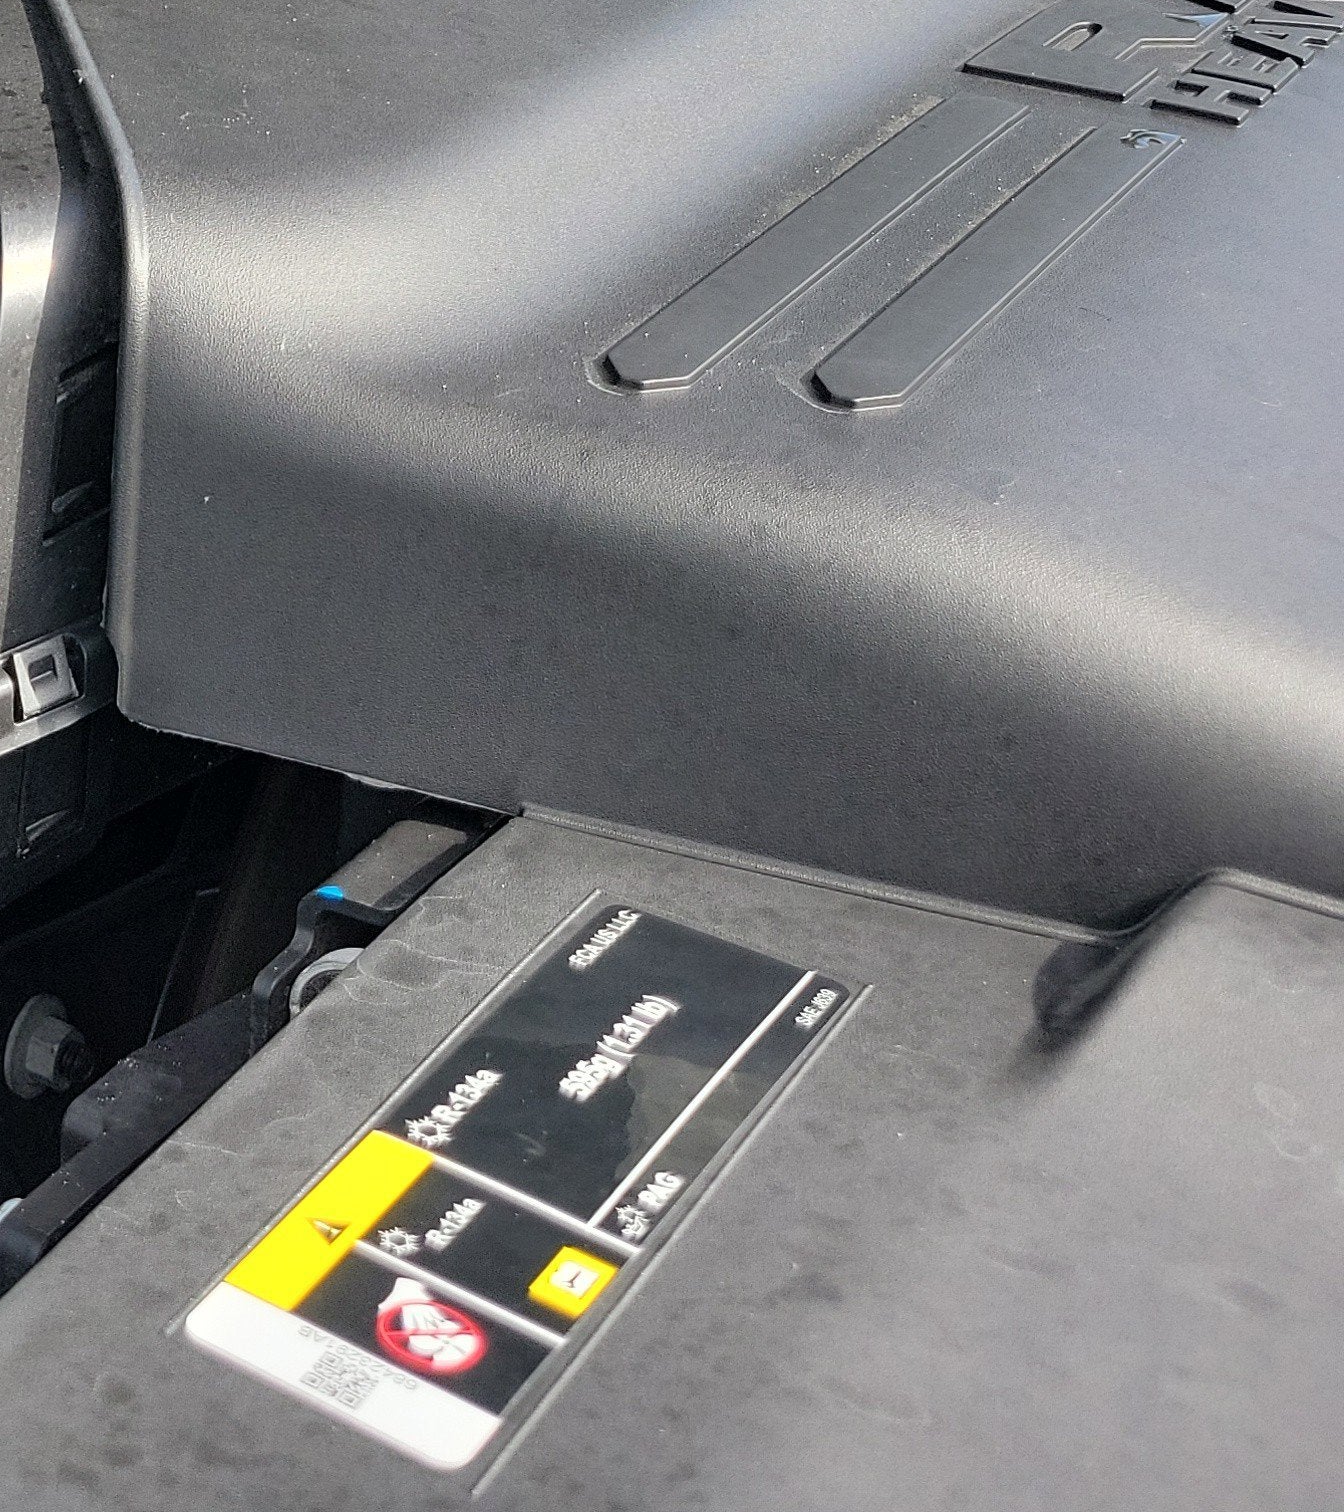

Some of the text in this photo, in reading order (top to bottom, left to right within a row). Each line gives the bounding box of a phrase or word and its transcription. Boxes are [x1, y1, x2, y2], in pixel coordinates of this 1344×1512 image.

[568, 909, 642, 969] FCA US LLC
[794, 988, 838, 1028] SAE J639
[558, 1053, 630, 1104] 595g
[631, 994, 682, 1021] lb)
[430, 1069, 504, 1126] R-134a
[637, 1171, 685, 1212] PAG
[424, 1198, 487, 1252] R-134a
